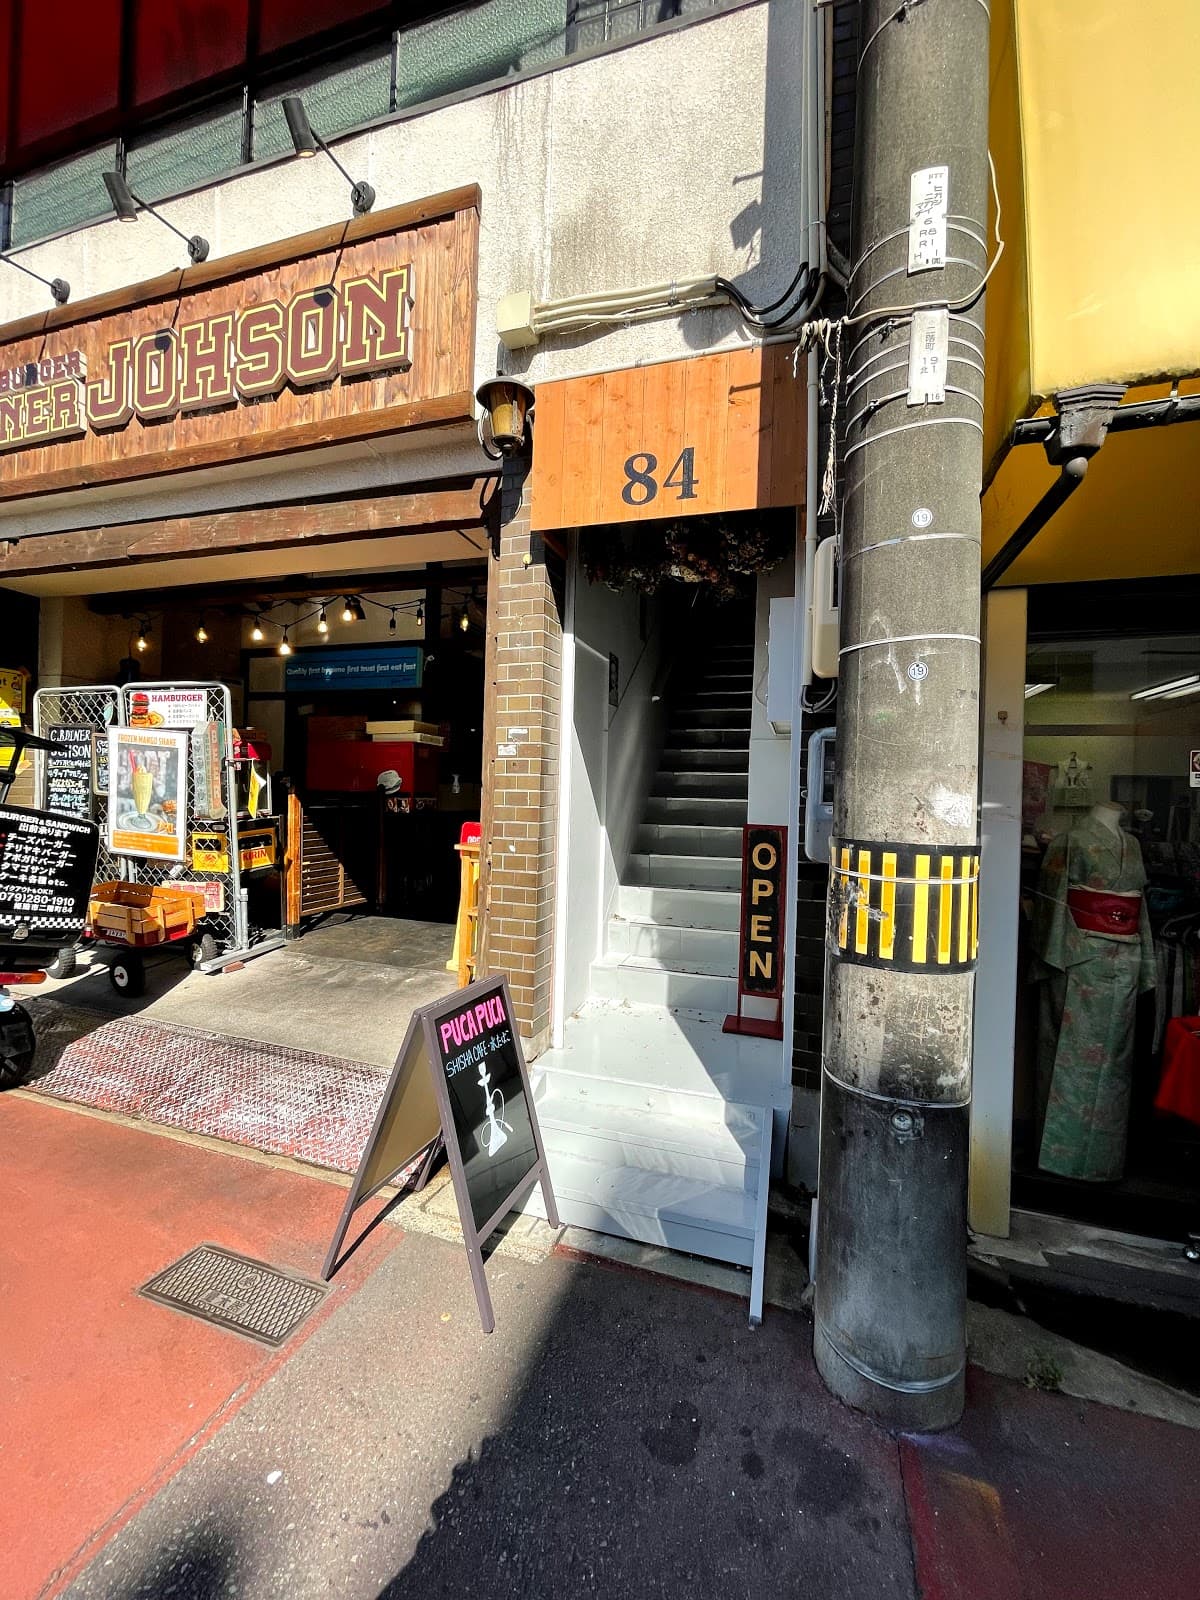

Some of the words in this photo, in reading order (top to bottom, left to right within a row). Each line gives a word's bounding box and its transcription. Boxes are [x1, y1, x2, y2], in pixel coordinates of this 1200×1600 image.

[87, 264, 411, 425] JOHSON
[621, 447, 699, 506] 84
[914, 512, 929, 524] 19
[910, 666, 925, 677] 19
[151, 694, 204, 703] HAMBURGER
[18, 823, 71, 838] 出前承ります
[45, 819, 91, 834] SANDWICH
[7, 832, 72, 848] チーズバーガー
[4, 842, 77, 859] テリヤキバーガー
[242, 849, 269, 861] KIRIN
[0, 861, 56, 876] タマゴサンド
[748, 842, 777, 979] OPEN
[440, 1010, 477, 1054] PUCA
[474, 995, 507, 1034] PUCA
[446, 1049, 473, 1078] SHISHA
